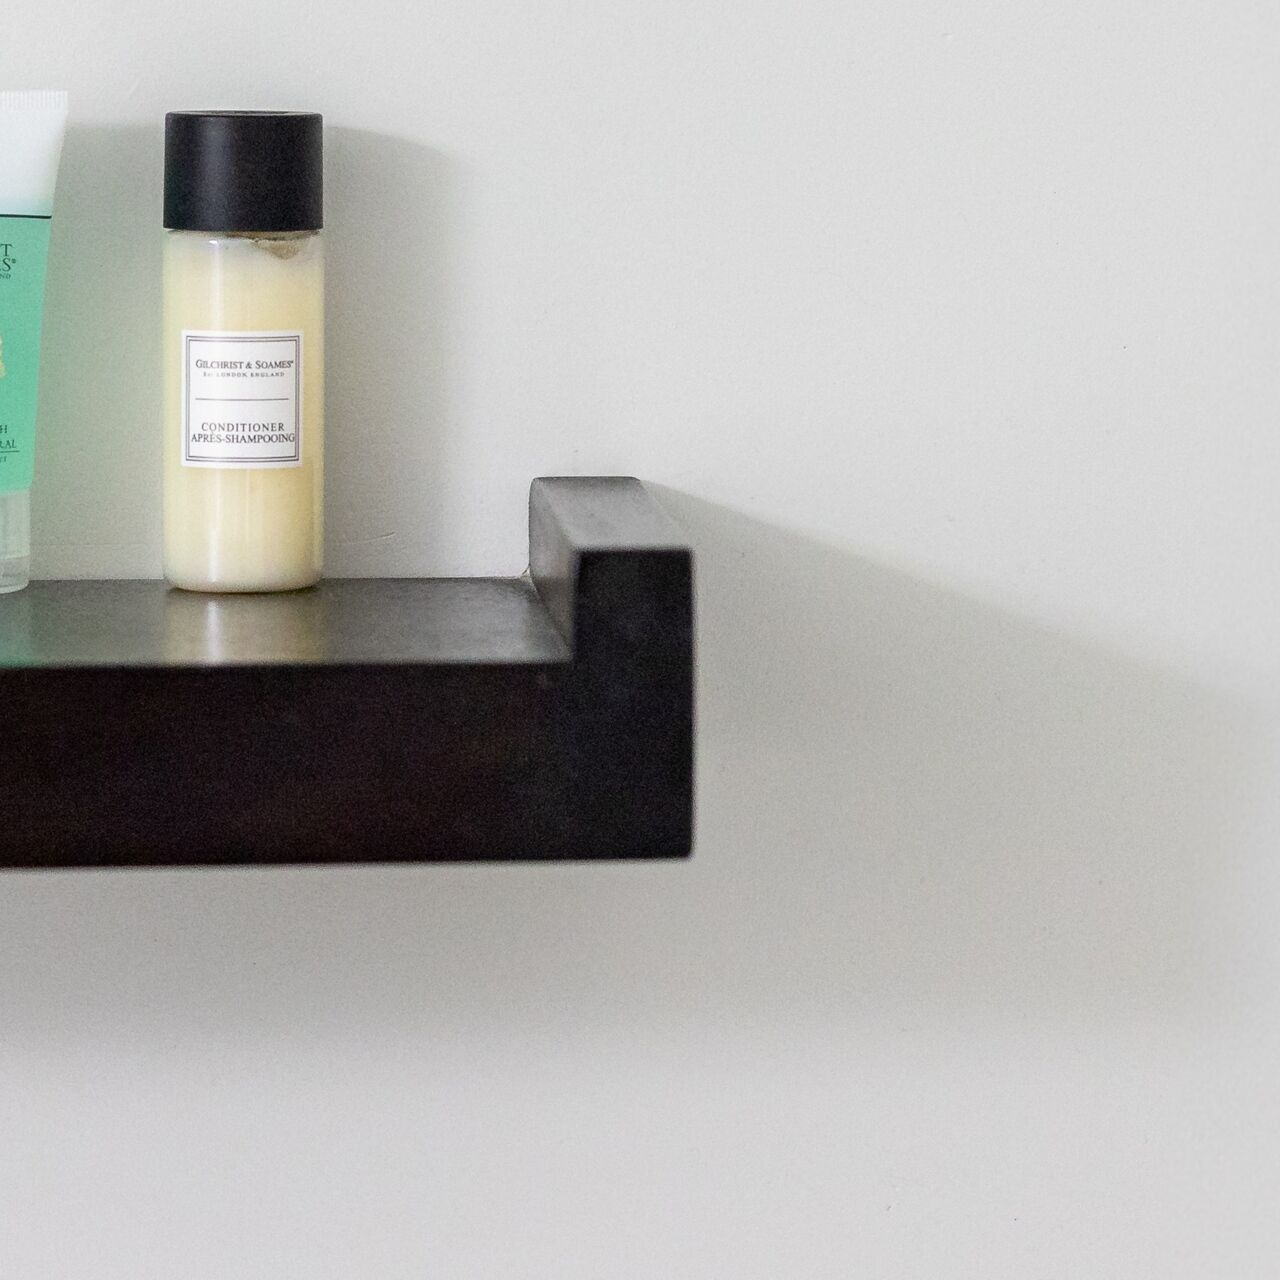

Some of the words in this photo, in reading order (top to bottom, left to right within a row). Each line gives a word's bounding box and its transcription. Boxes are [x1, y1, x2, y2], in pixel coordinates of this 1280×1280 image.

[195, 359, 244, 369] GILCHRIST
[245, 361, 252, 369] &
[201, 422, 285, 432] CONDITIONER
